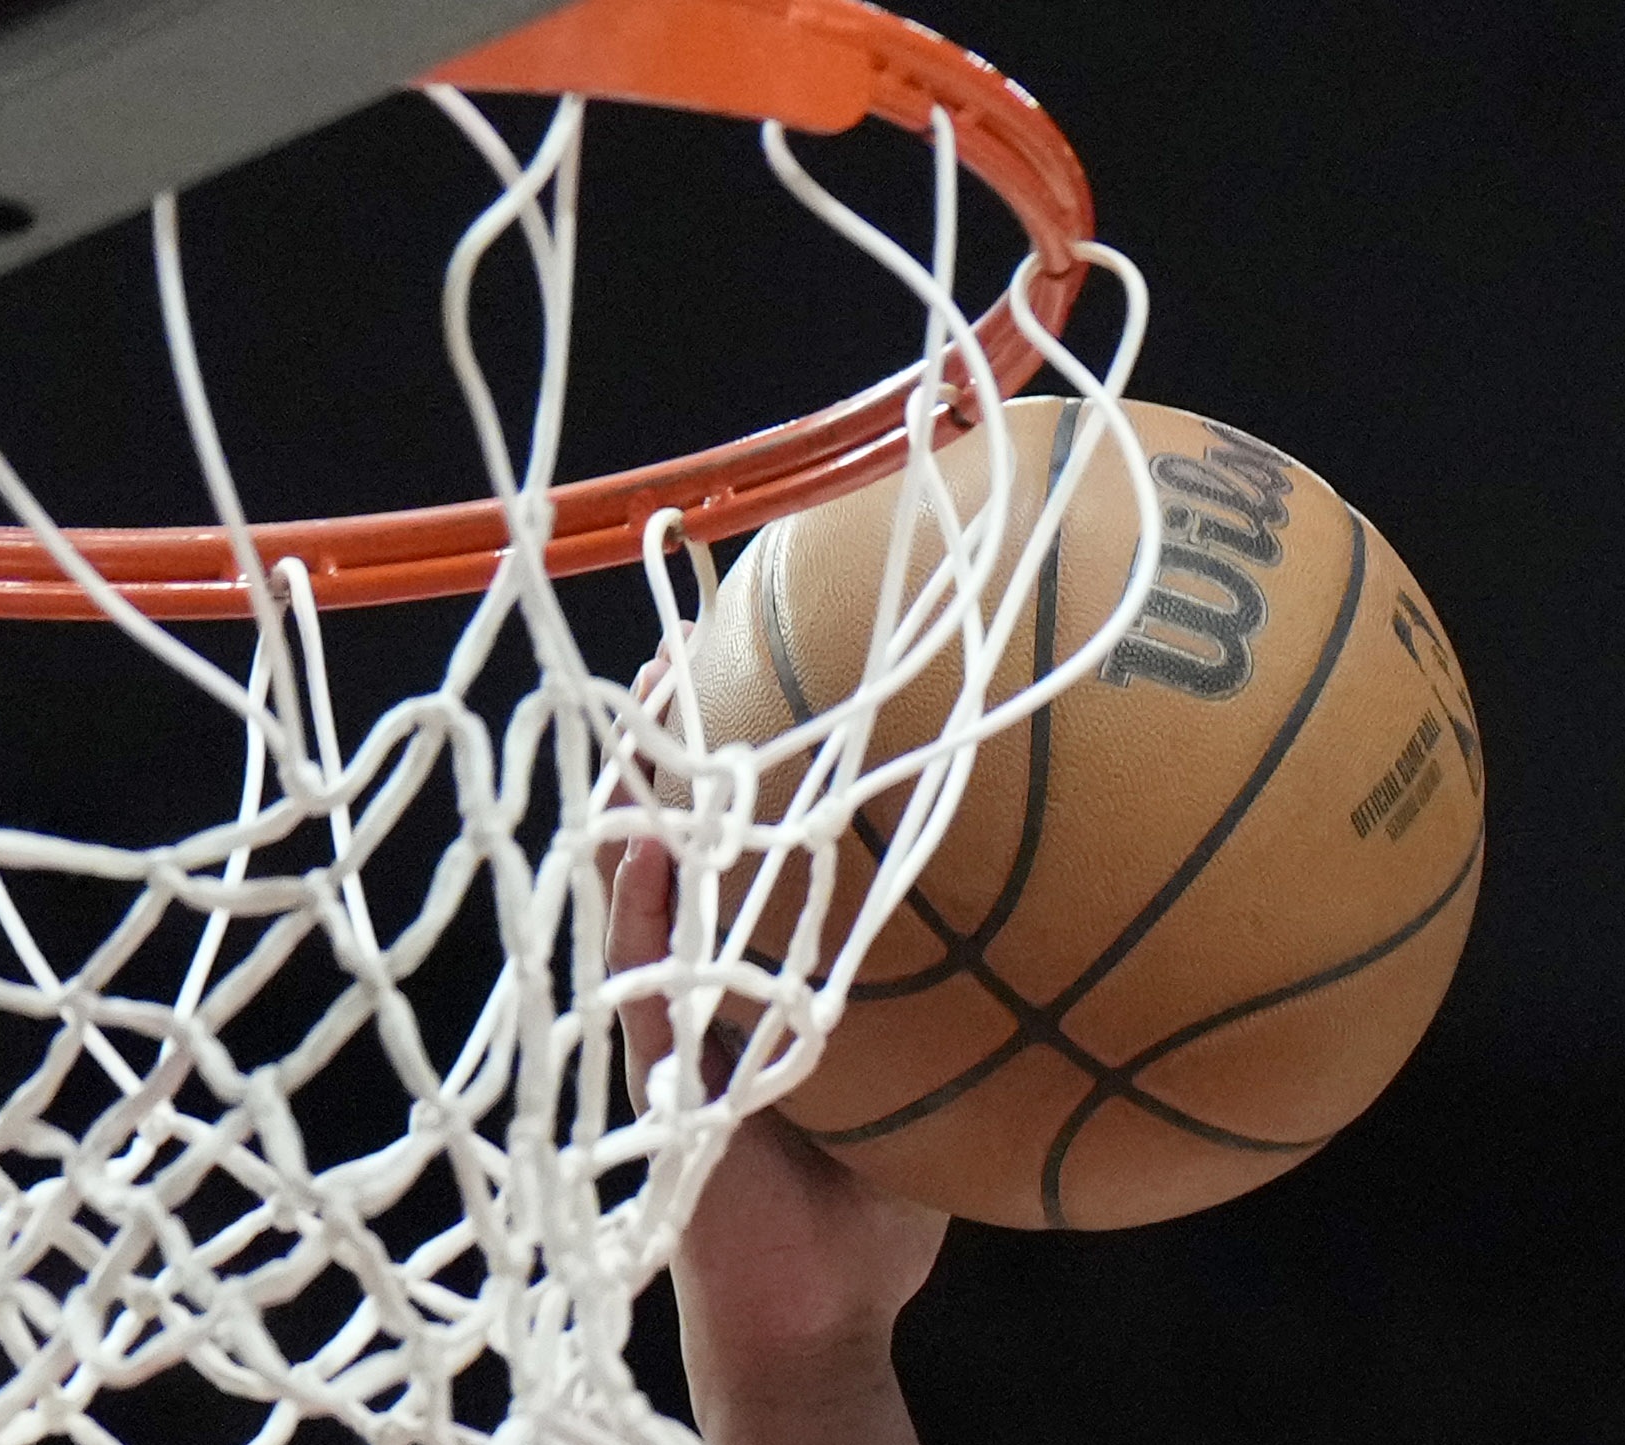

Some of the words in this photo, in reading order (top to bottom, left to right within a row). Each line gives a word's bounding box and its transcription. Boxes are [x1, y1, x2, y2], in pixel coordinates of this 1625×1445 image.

[1099, 418, 1295, 702] Wils
[1349, 766, 1404, 840] OFFICIAL
[1394, 730, 1427, 786] GAME
